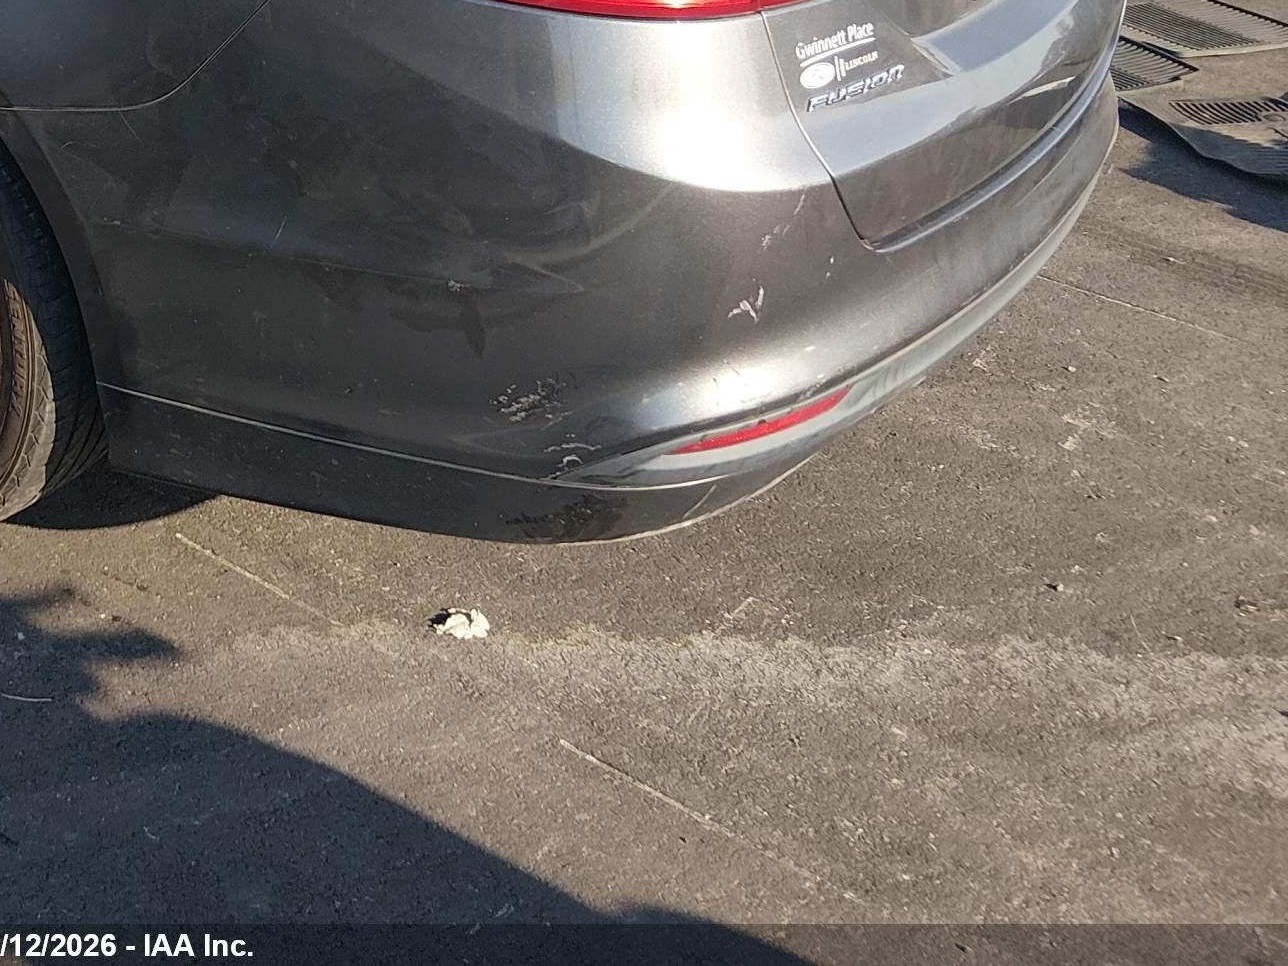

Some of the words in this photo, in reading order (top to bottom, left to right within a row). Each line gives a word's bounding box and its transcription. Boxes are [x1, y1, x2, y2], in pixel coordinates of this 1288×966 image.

[795, 29, 847, 59] Gwinnett
[846, 22, 875, 42] Place
[806, 64, 905, 113] FUSION
